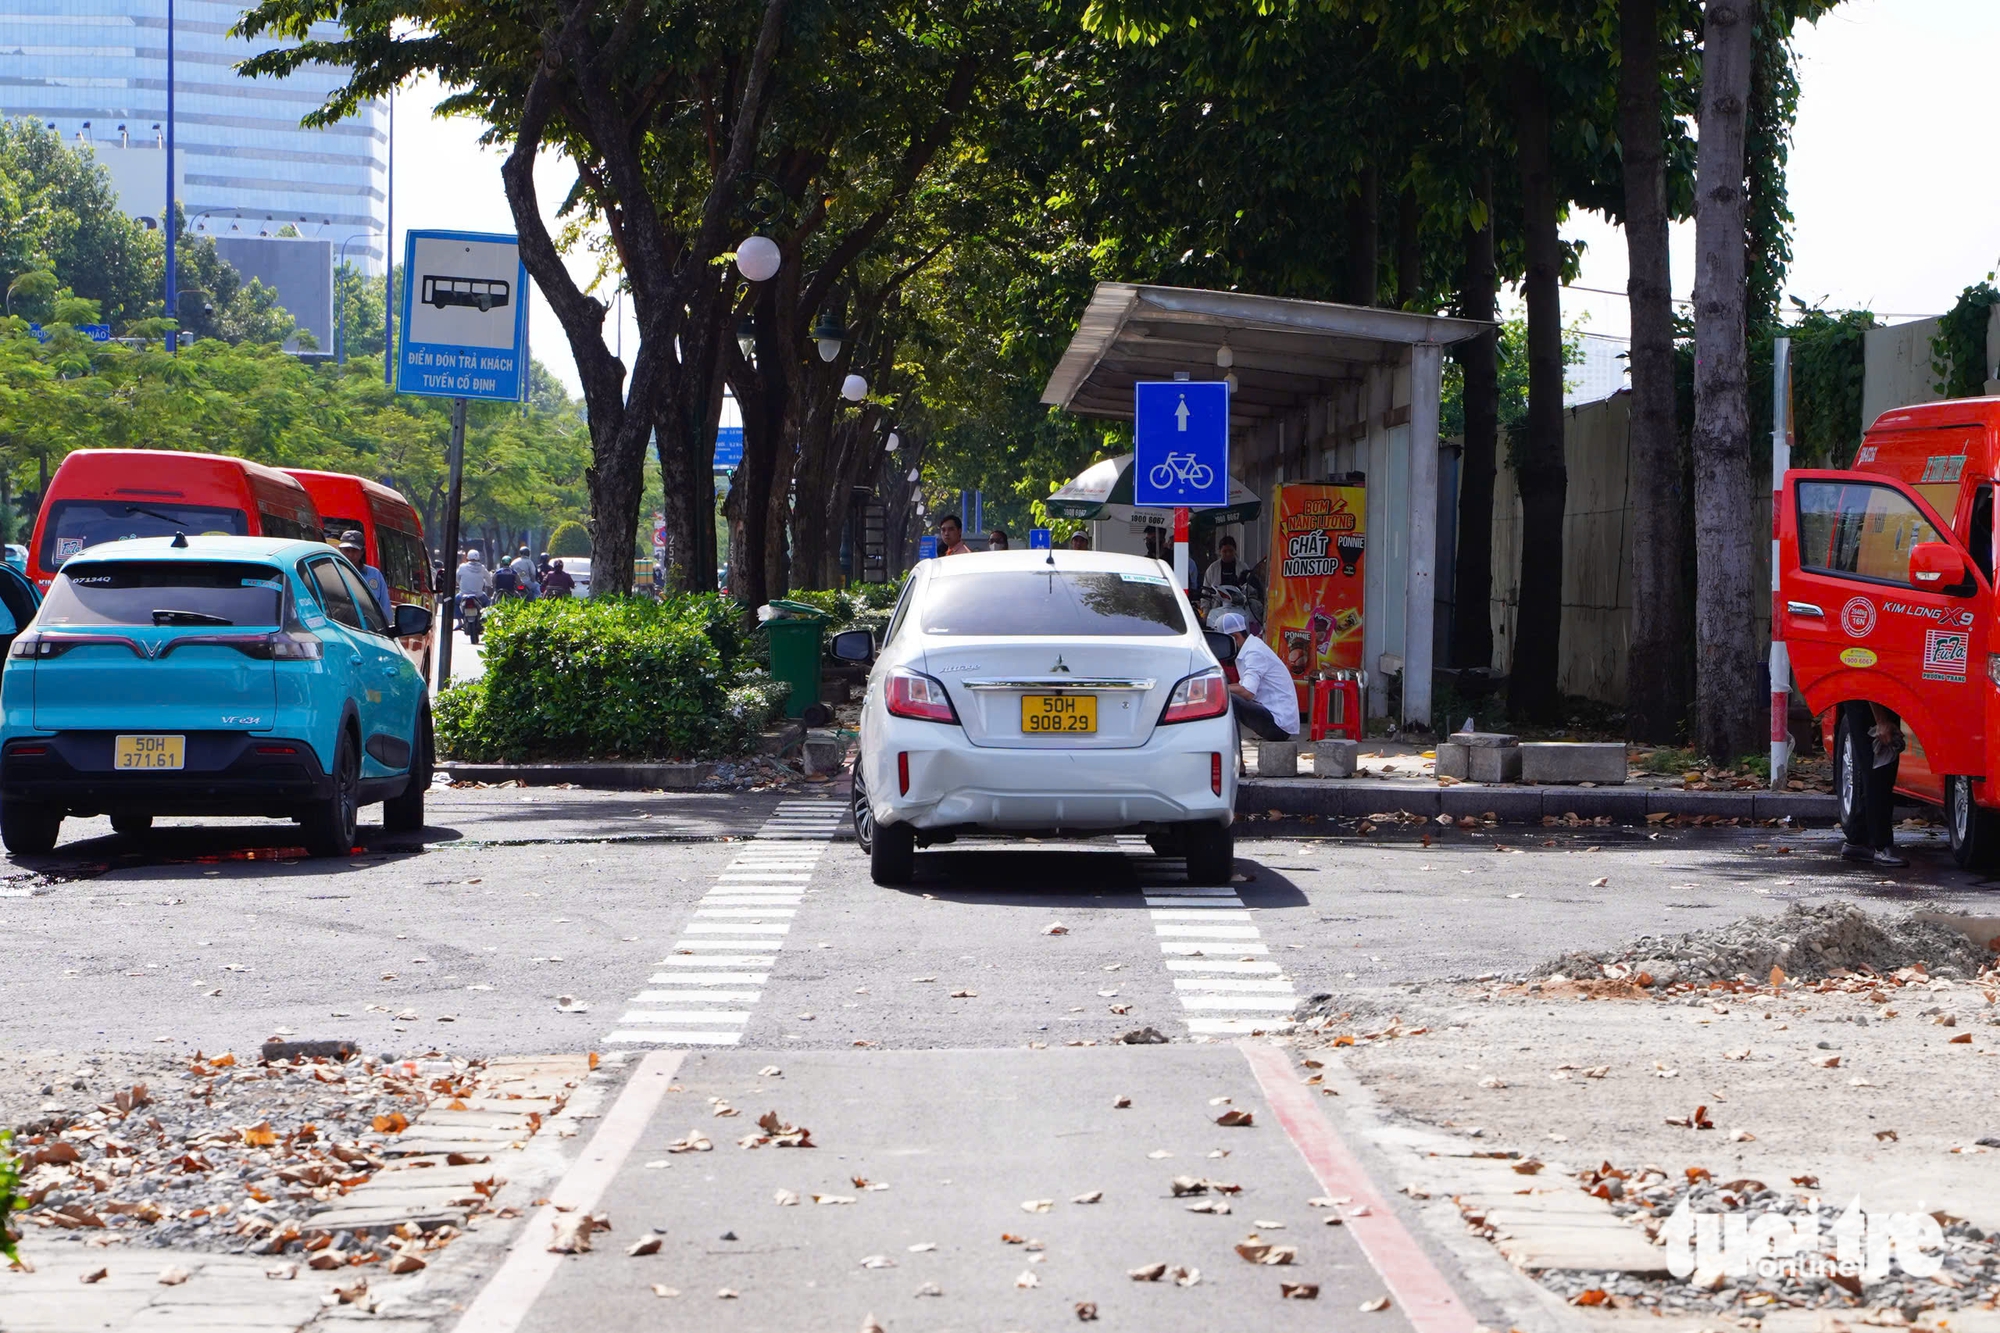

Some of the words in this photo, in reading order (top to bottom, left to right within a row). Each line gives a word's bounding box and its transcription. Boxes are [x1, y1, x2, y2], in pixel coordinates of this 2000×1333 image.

[408, 347, 433, 366] ĐIỂM
[436, 351, 456, 367] ĐÓN
[459, 353, 477, 369] TRẢ
[480, 355, 513, 371] KHÁCH
[423, 372, 454, 388] TUYẾN
[456, 373, 471, 390] CỐ
[472, 378, 496, 393] ĐỊNH
[1305, 500, 1330, 515] BƠM
[1131, 514, 1147, 523] 1900
[1148, 516, 1165, 525] 6067
[1289, 530, 1329, 557] CHẤT
[1337, 536, 1365, 549] PONNIE
[72, 576, 111, 584] 07134Q
[1882, 601, 1906, 614] KIM
[1906, 606, 1942, 619] LONG
[1284, 631, 1311, 641] PONNIE
[1043, 698, 1075, 713] 50H
[221, 716, 238, 724] VF
[239, 716, 261, 725] e34
[1030, 715, 1089, 731] 908.29
[135, 738, 165, 751] 50H
[123, 753, 175, 768] 371.61
